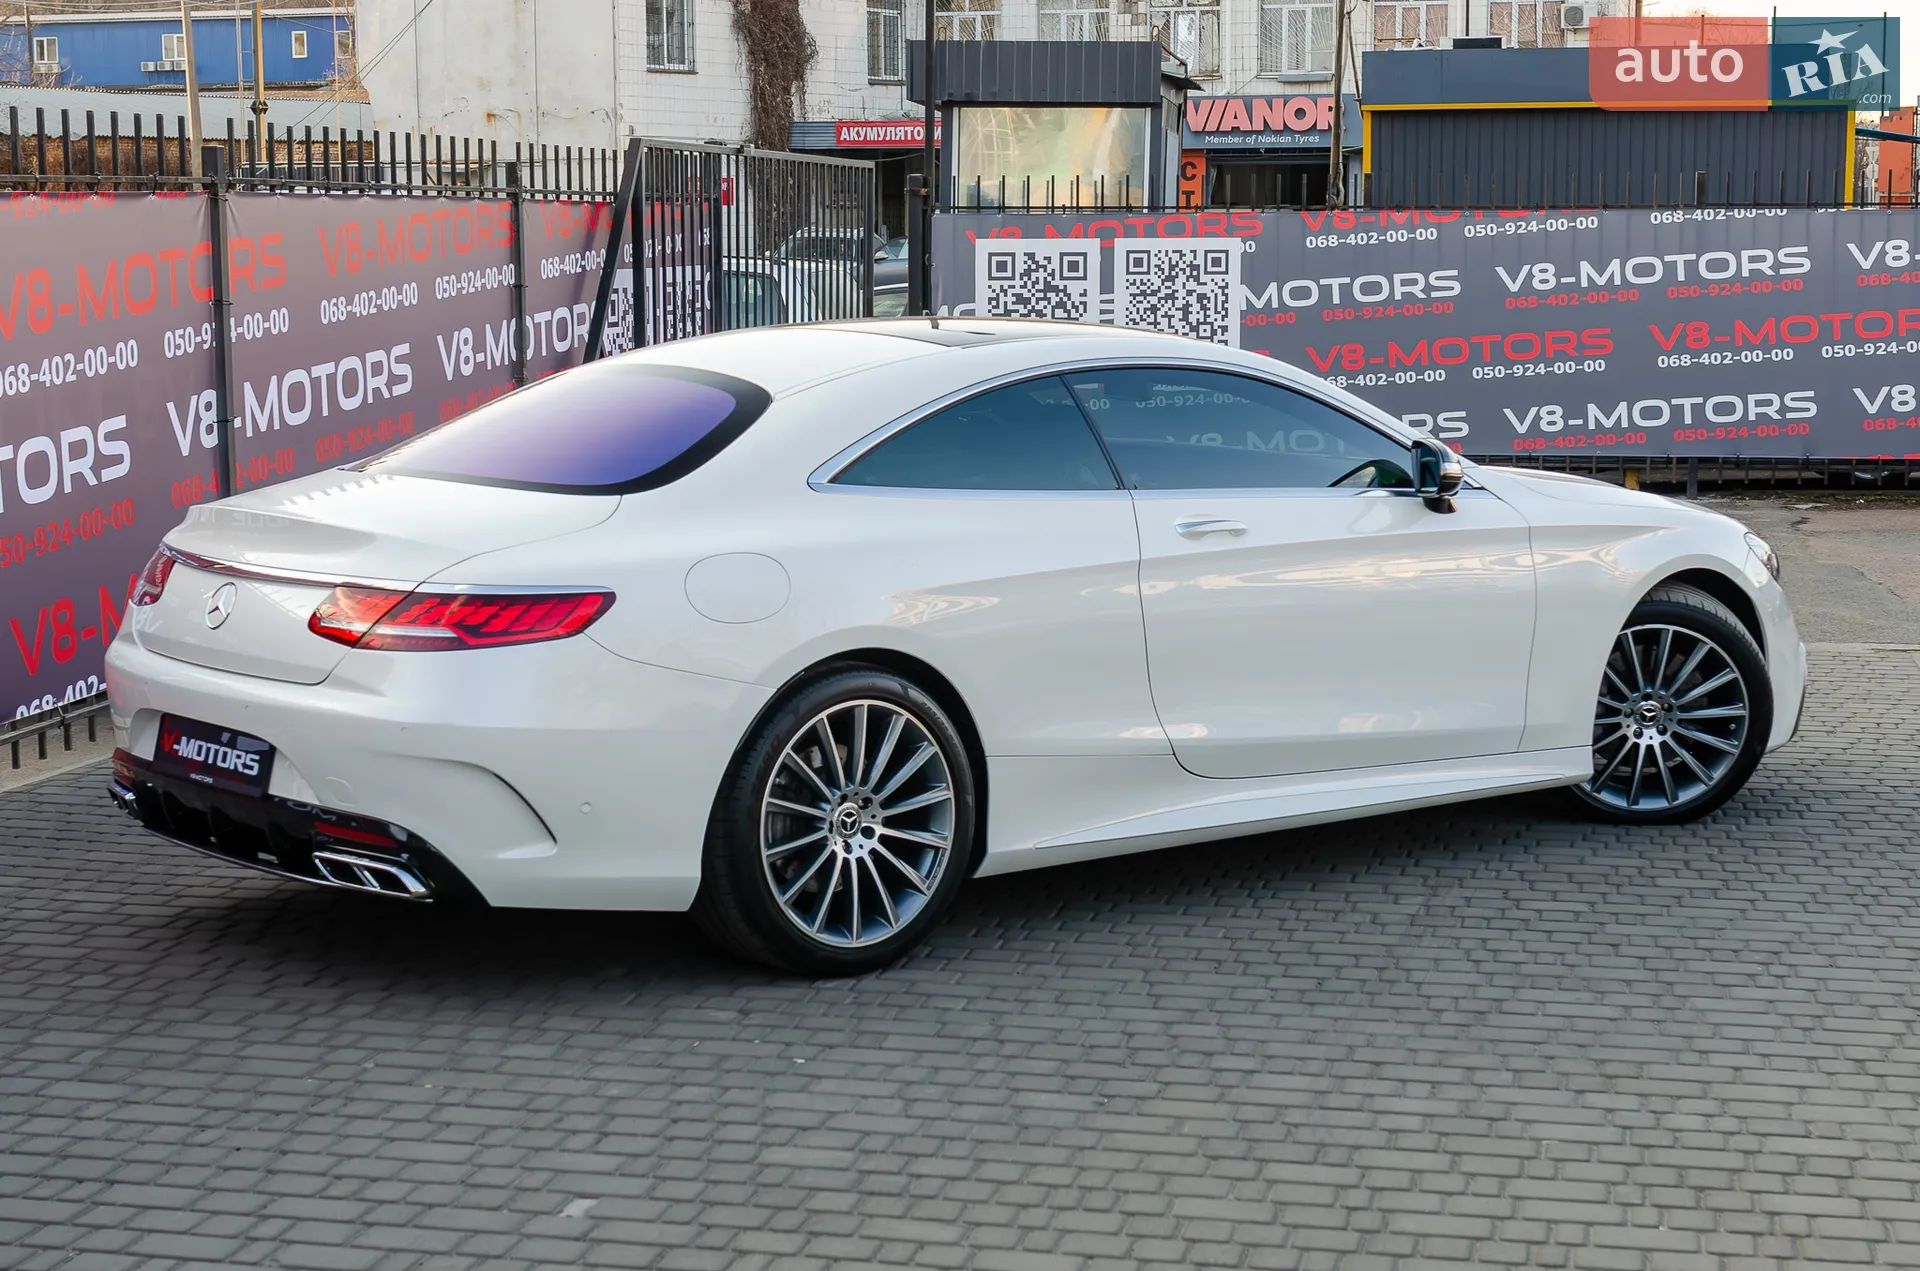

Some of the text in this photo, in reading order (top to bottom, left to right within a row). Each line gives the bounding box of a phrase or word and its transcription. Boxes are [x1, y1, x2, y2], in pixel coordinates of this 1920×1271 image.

[840, 126, 941, 141] АКУМУЛЯТОИ
[1205, 134, 1320, 145] Member of Nokian Tyres
[317, 201, 515, 279] V8-MOTORS
[1305, 227, 1438, 249] 068-402-00-00
[1463, 216, 1599, 238] 050-924-00-00
[541, 248, 606, 280] 068-402-00-0
[1494, 246, 1812, 293] V8-MOTORS
[435, 263, 515, 300] 050-924-00-00
[1666, 279, 1804, 299] 050-924-00-00
[320, 281, 418, 325] 068-402-00-00
[1322, 301, 1454, 321] 050-924-00-00
[1504, 288, 1640, 310] 068-402-00-00
[437, 299, 597, 382] V8-MOTOR
[1305, 327, 1614, 373] V8-MOTORS
[1821, 340, 1920, 358] 050-924-0
[0, 338, 139, 398] 68-402-00-00
[1471, 359, 1606, 380] 050-924-00-00
[1657, 348, 1794, 368] 068-402-00-00
[1319, 369, 1447, 388] 68-402-00-00
[166, 342, 413, 457] V8-MOTORS
[1503, 390, 1818, 434] V8-MOTORS
[315, 410, 416, 462] 050-924-00-00
[1512, 431, 1647, 451] 068-402-00-00
[1673, 423, 1810, 442] 050-924-00-00
[171, 447, 295, 509] 068-42-00-00
[163, 731, 261, 776] V-MOTORS
